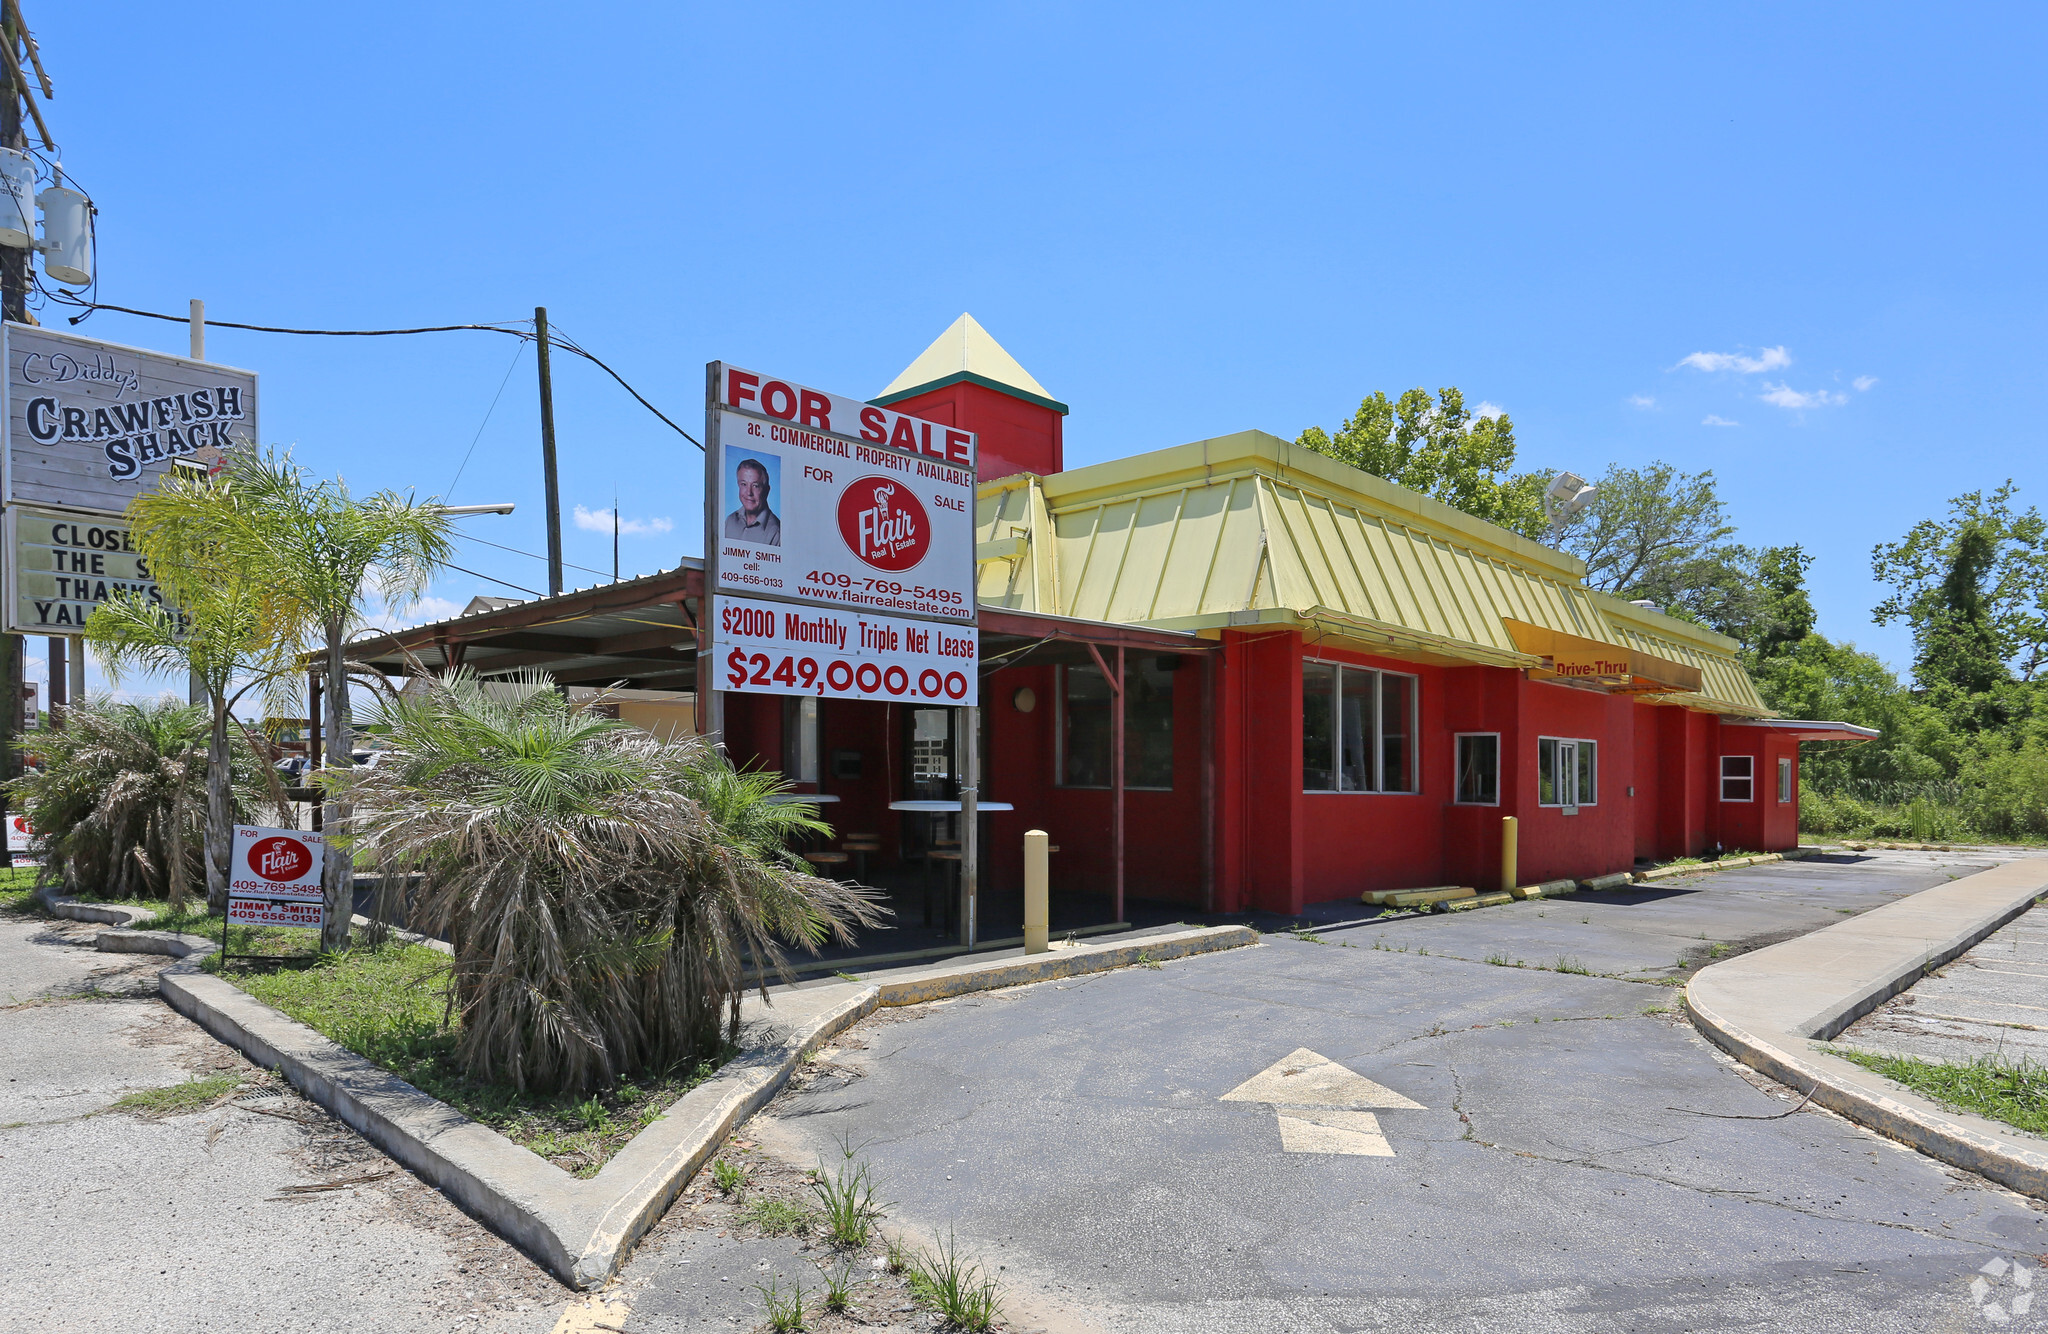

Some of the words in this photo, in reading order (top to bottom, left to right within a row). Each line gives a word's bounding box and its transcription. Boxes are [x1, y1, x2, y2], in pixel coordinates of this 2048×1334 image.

[26, 386, 246, 446] CRAWFISH
[728, 368, 832, 431] FOR
[859, 406, 971, 466] SALE
[104, 420, 236, 482] SHACK
[747, 422, 765, 438] ac.
[771, 424, 850, 459] COMMERCIAL
[856, 445, 911, 473] PROPERTY
[916, 461, 970, 488] AVAILABLE
[804, 465, 833, 484] FOR
[934, 494, 965, 512] SALE
[858, 506, 915, 557] Flair
[722, 547, 751, 559] JIMMY
[755, 551, 781, 563] SMITH
[871, 547, 887, 559] Real
[895, 538, 916, 551] Estate
[53, 550, 104, 575] THE
[743, 562, 760, 572] cell:
[721, 571, 783, 588] 409-656-0133
[806, 570, 963, 605] 409-769-5495
[797, 586, 970, 618] www.flairrealestate.com
[722, 606, 775, 638] $2000
[785, 612, 847, 651] Monthly
[858, 621, 898, 654] Triple
[906, 627, 929, 654] Net
[938, 631, 974, 659] Lease
[727, 647, 968, 700] $249,000.00
[1556, 660, 1628, 676] Drive-Thru
[240, 829, 258, 838] FOR
[302, 835, 323, 843] SALE
[262, 849, 299, 875] Flair
[232, 880, 323, 895] 409-769-5495
[230, 910, 320, 923] 409-656-0133
[231, 902, 273, 912] JIMMY
[281, 905, 321, 915] SMITH
